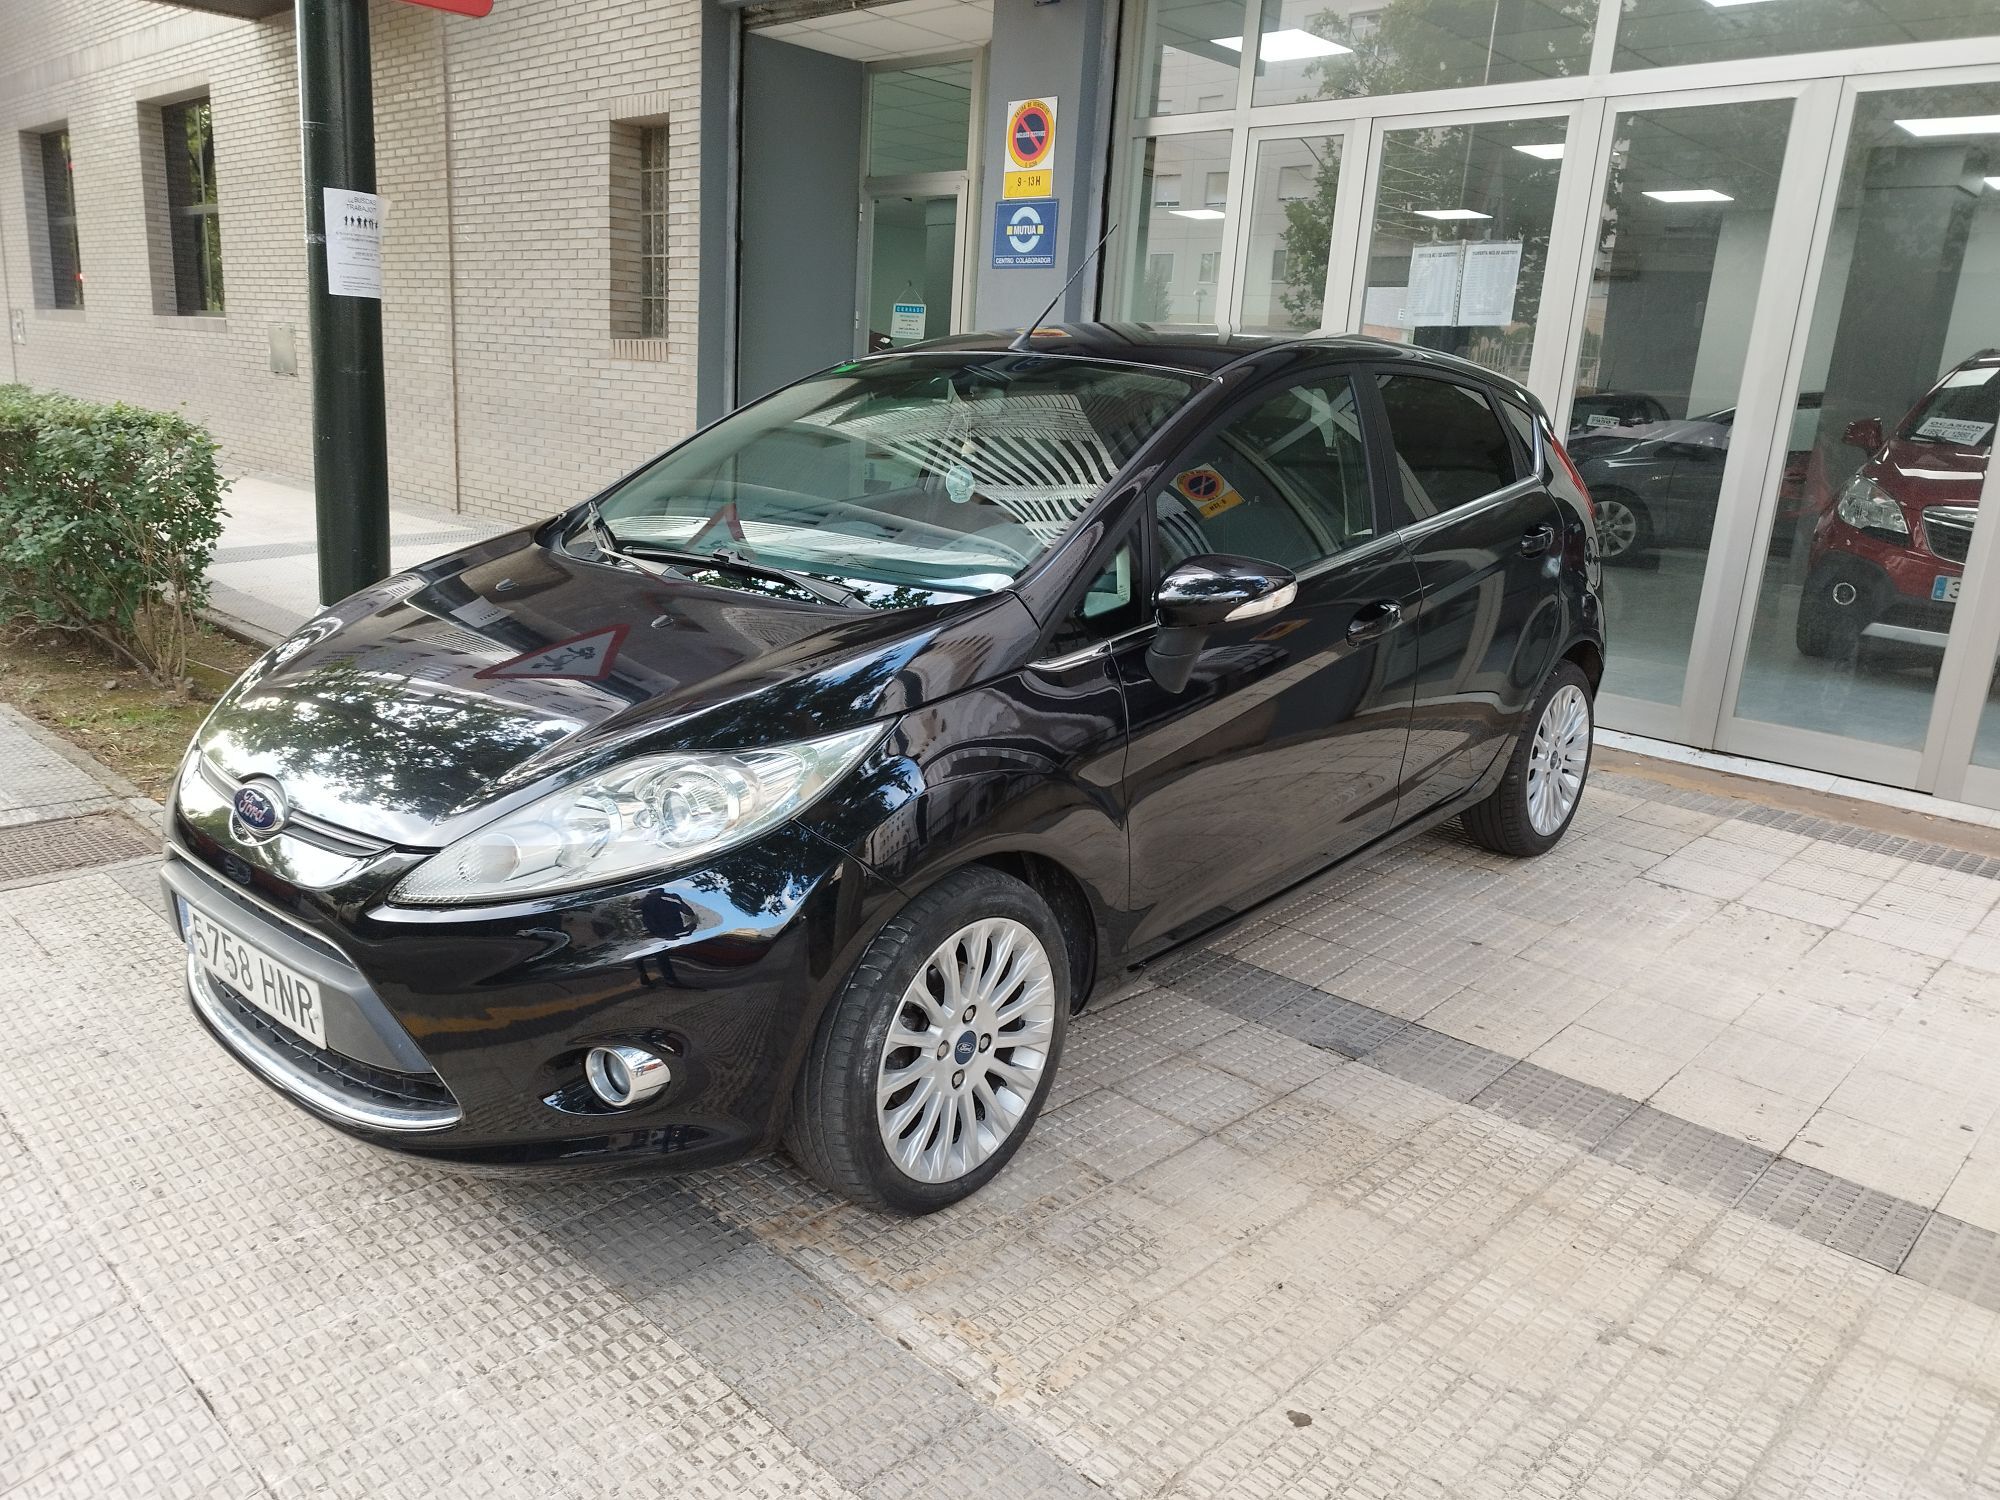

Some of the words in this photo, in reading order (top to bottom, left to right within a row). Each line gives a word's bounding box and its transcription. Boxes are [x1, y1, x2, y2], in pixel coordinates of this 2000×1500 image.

[1017, 176, 1022, 187] 9
[1013, 225, 1037, 235] MUTUA
[1015, 256, 1052, 264] COLABORADOR
[237, 789, 269, 824] Ford
[192, 913, 254, 992] 5758
[259, 957, 317, 1035] HNR
